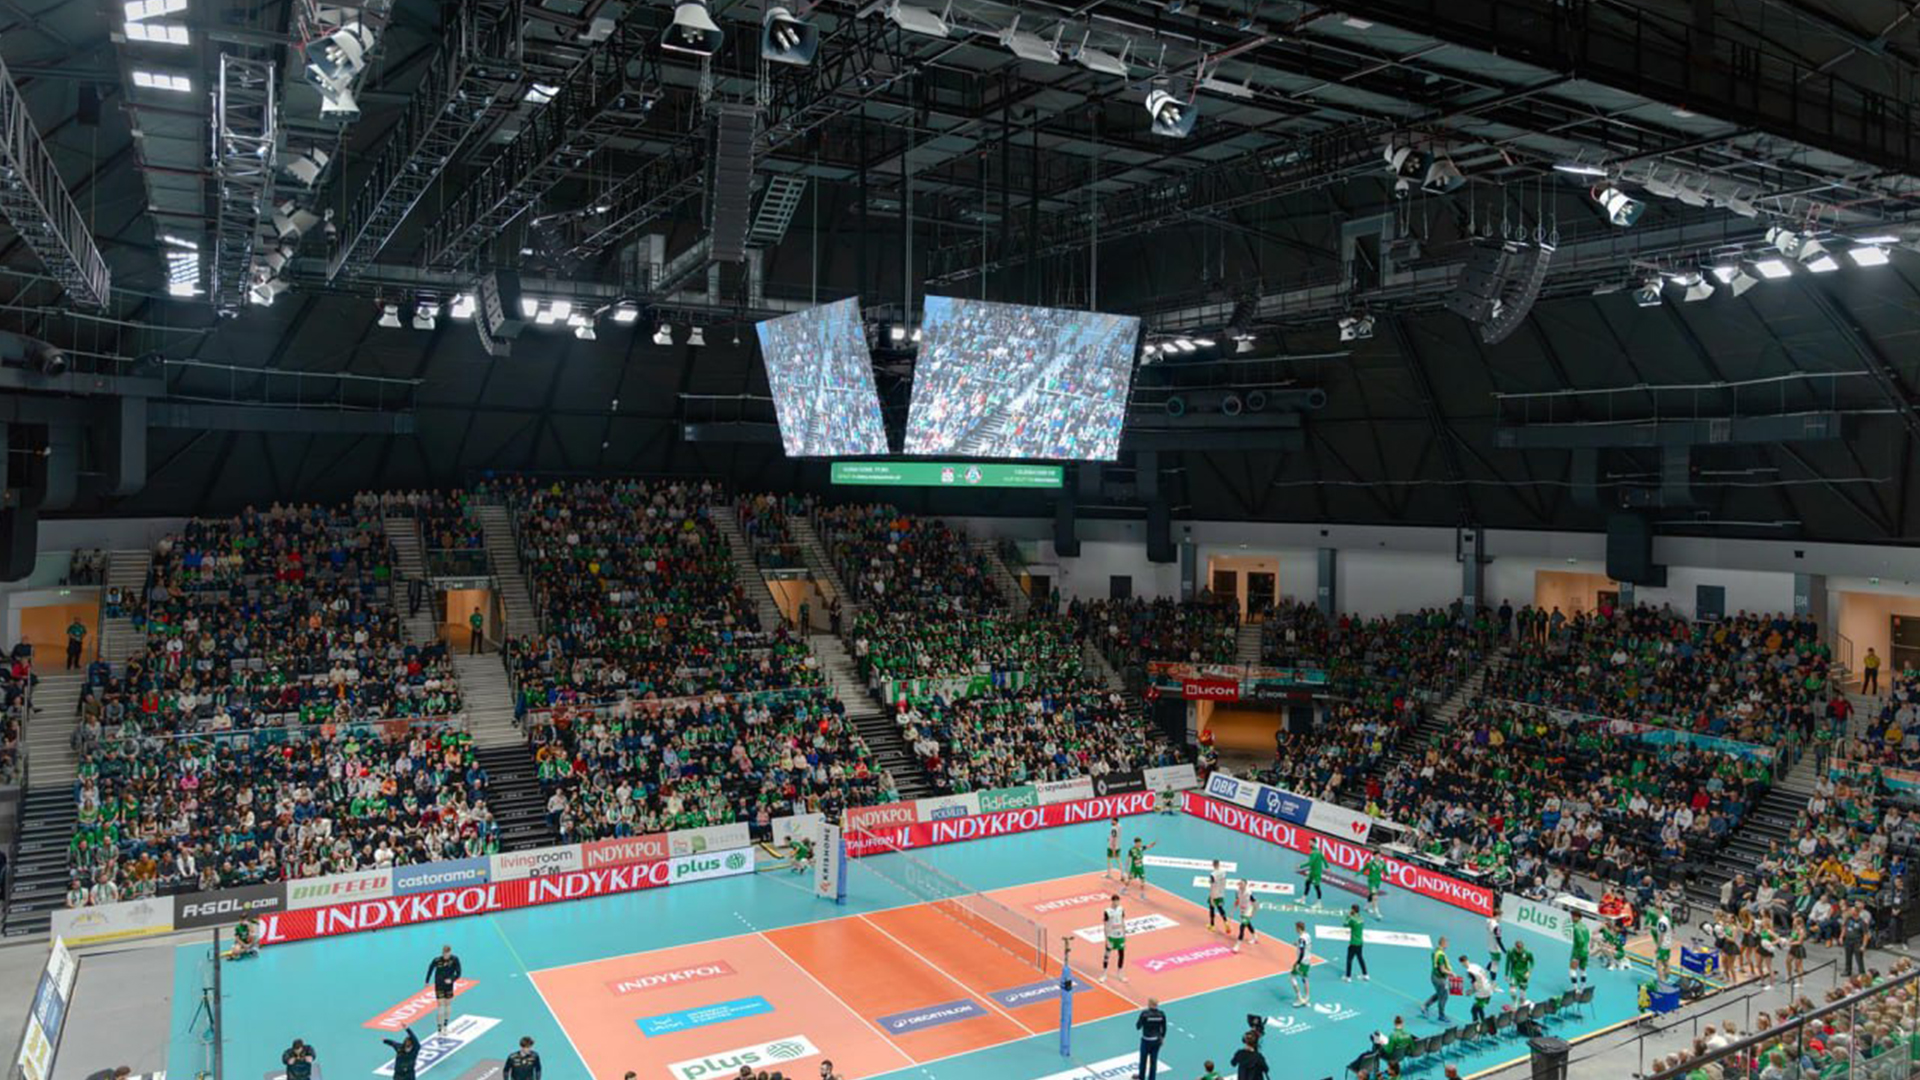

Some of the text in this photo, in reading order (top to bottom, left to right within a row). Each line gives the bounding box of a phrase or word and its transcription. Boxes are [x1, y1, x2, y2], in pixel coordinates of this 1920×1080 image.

[1211, 775, 1238, 798] DBK
[852, 807, 915, 831] INDYKPOL
[932, 807, 1048, 842] INDYKPOL
[1204, 802, 1300, 849] INDYKPOL
[500, 850, 573, 867] livingroom
[588, 842, 664, 866] INDYKPOL
[1315, 837, 1417, 889] INDYPO
[398, 868, 476, 889] castorama
[676, 858, 720, 878] plus
[1417, 872, 1491, 910] INDYKPOL
[315, 886, 502, 935] INDYKPOL
[1517, 904, 1558, 930] plus
[617, 965, 726, 993] INDYKPOL
[681, 1051, 761, 1080] plus
